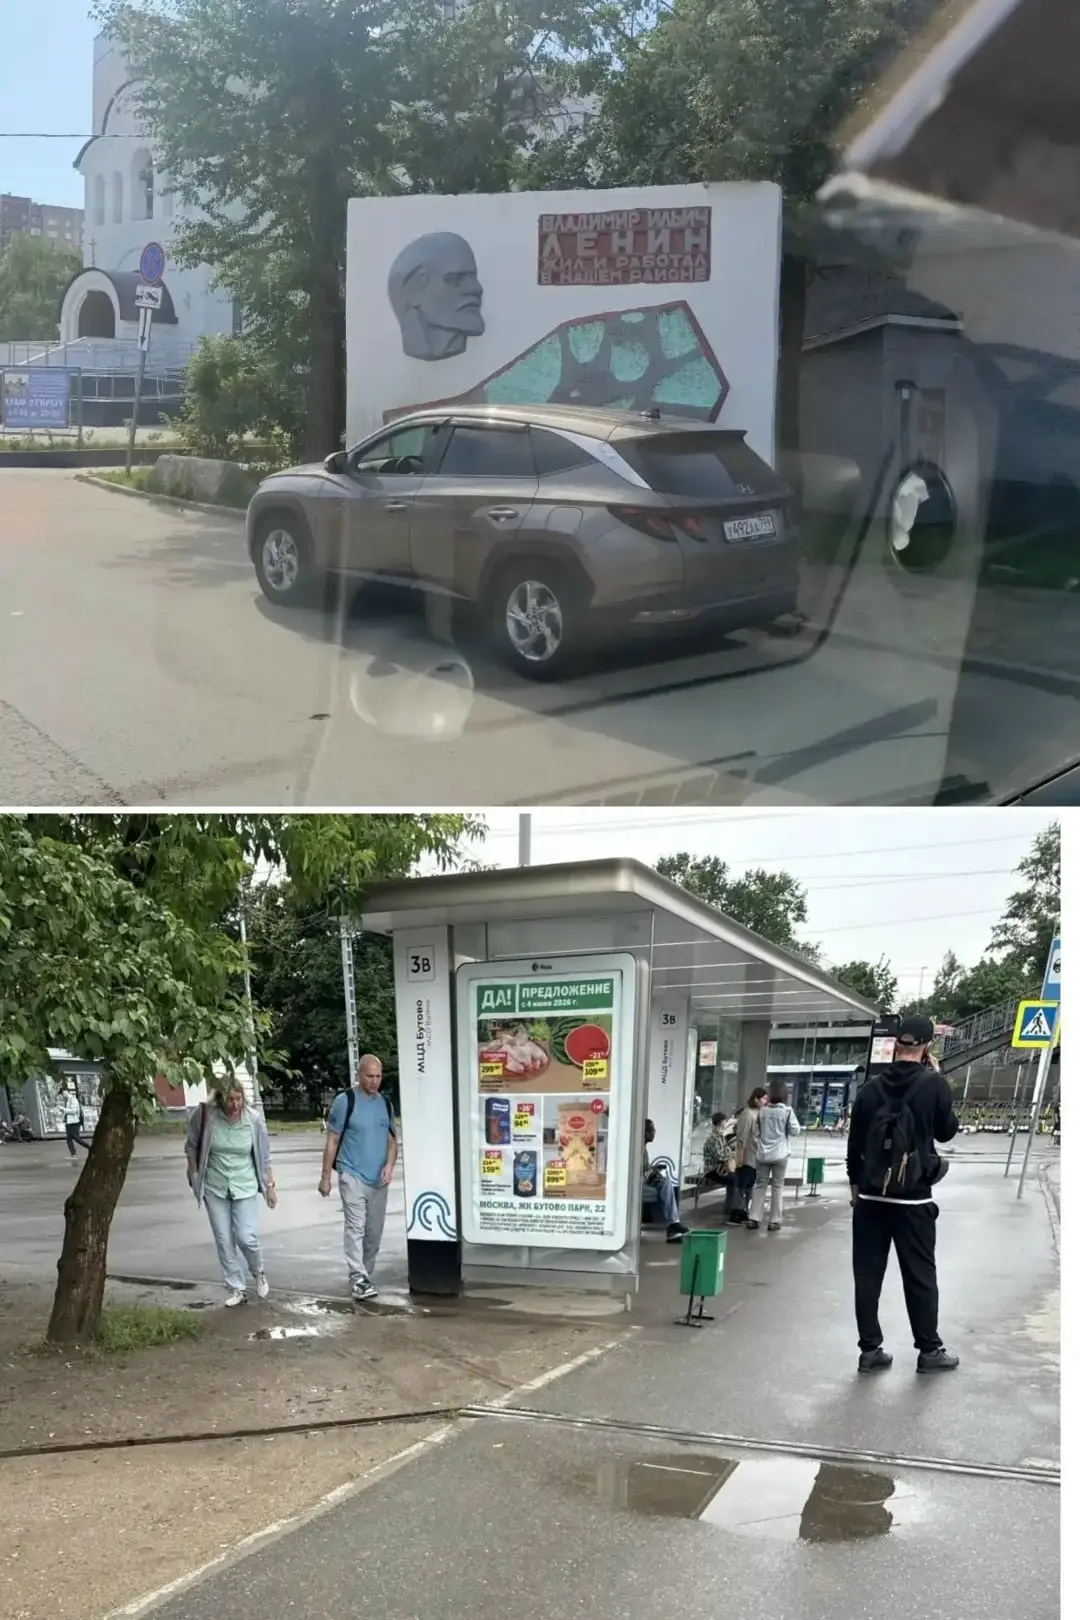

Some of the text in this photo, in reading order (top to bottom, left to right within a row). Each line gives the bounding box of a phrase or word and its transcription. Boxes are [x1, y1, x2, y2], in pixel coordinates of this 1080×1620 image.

[541, 208, 709, 232] ВЛАДИМИР ИЛЬИЧ
[542, 228, 708, 258] ЛЕНИН
[541, 253, 706, 271] ЖИЛ И РАБОТАЛ
[541, 271, 552, 284] В
[560, 269, 622, 284] НАШЕМ
[481, 983, 611, 1010] ДА! ПРЕДЛОЖЕНИЕ
[416, 999, 426, 1074] МЦД Бутово
[479, 1200, 606, 1214] МОСКВА, ЖК БУТОВО ПАРК, 22
